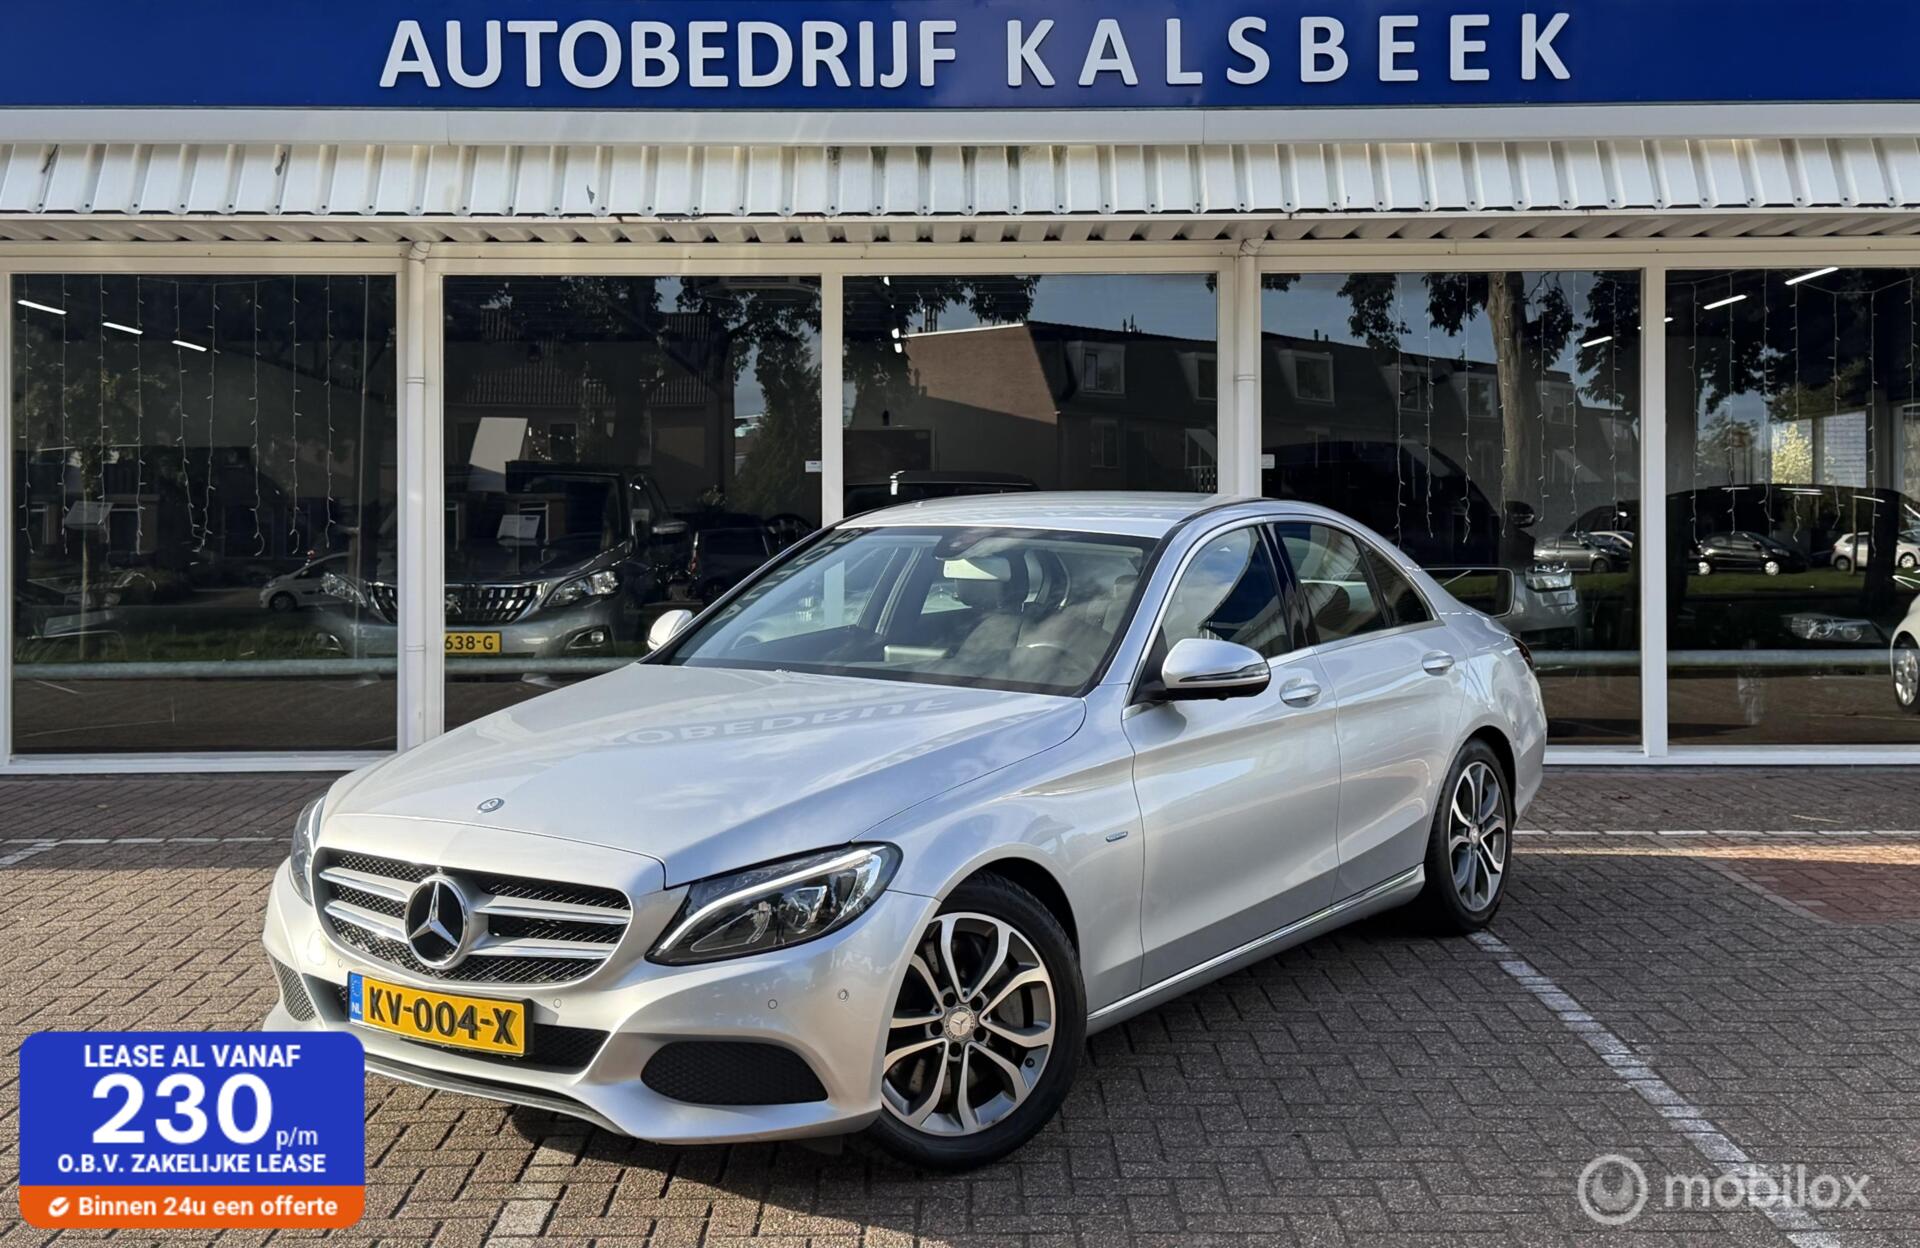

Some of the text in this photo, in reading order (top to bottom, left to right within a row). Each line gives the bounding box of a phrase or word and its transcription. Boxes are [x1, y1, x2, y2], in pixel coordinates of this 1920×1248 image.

[379, 12, 1571, 89] AUTOBEDRIJF KALSBEEK
[351, 1002, 362, 1015] NL
[369, 985, 518, 1047] KV-004-X
